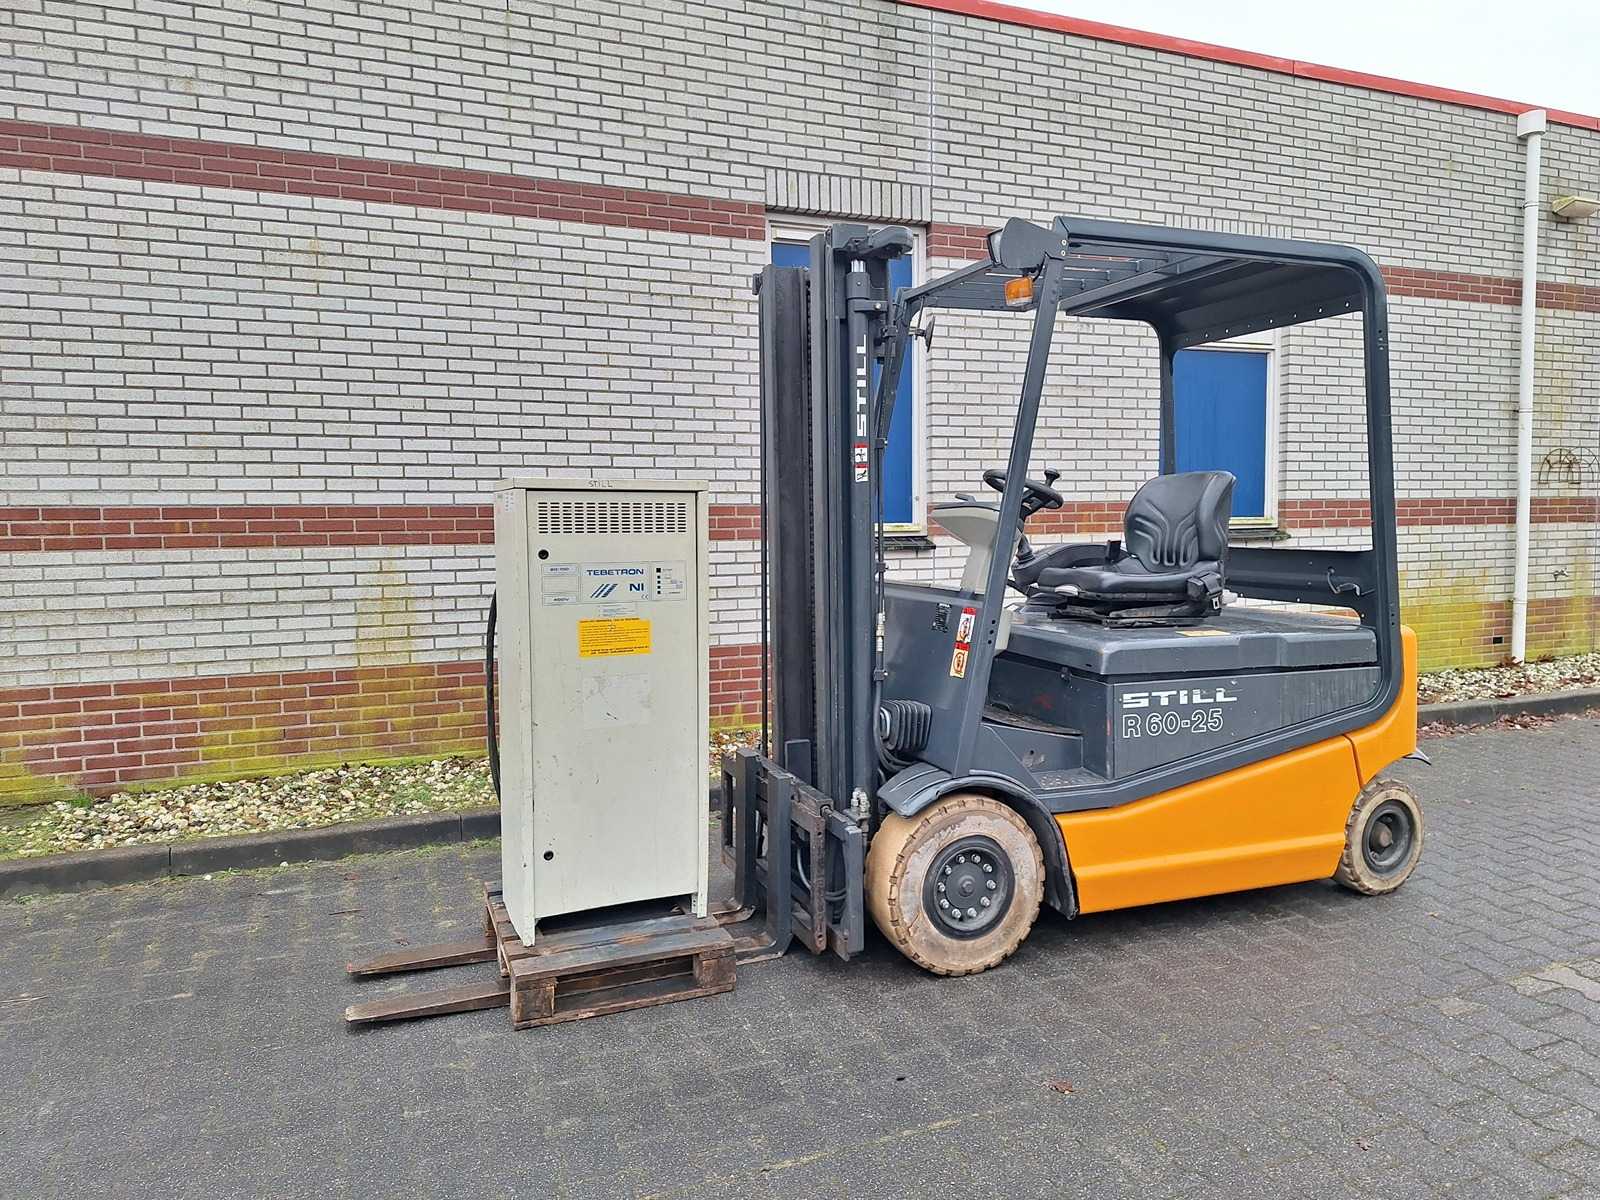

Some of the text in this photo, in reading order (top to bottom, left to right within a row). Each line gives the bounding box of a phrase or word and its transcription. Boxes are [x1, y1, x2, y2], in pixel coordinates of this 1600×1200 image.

[856, 334, 867, 437] STILL
[588, 480, 613, 488] STILL
[586, 568, 644, 576] TEBETRON
[629, 583, 644, 591] NI
[1122, 687, 1238, 708] STILL
[1122, 708, 1223, 738] R 60-25
